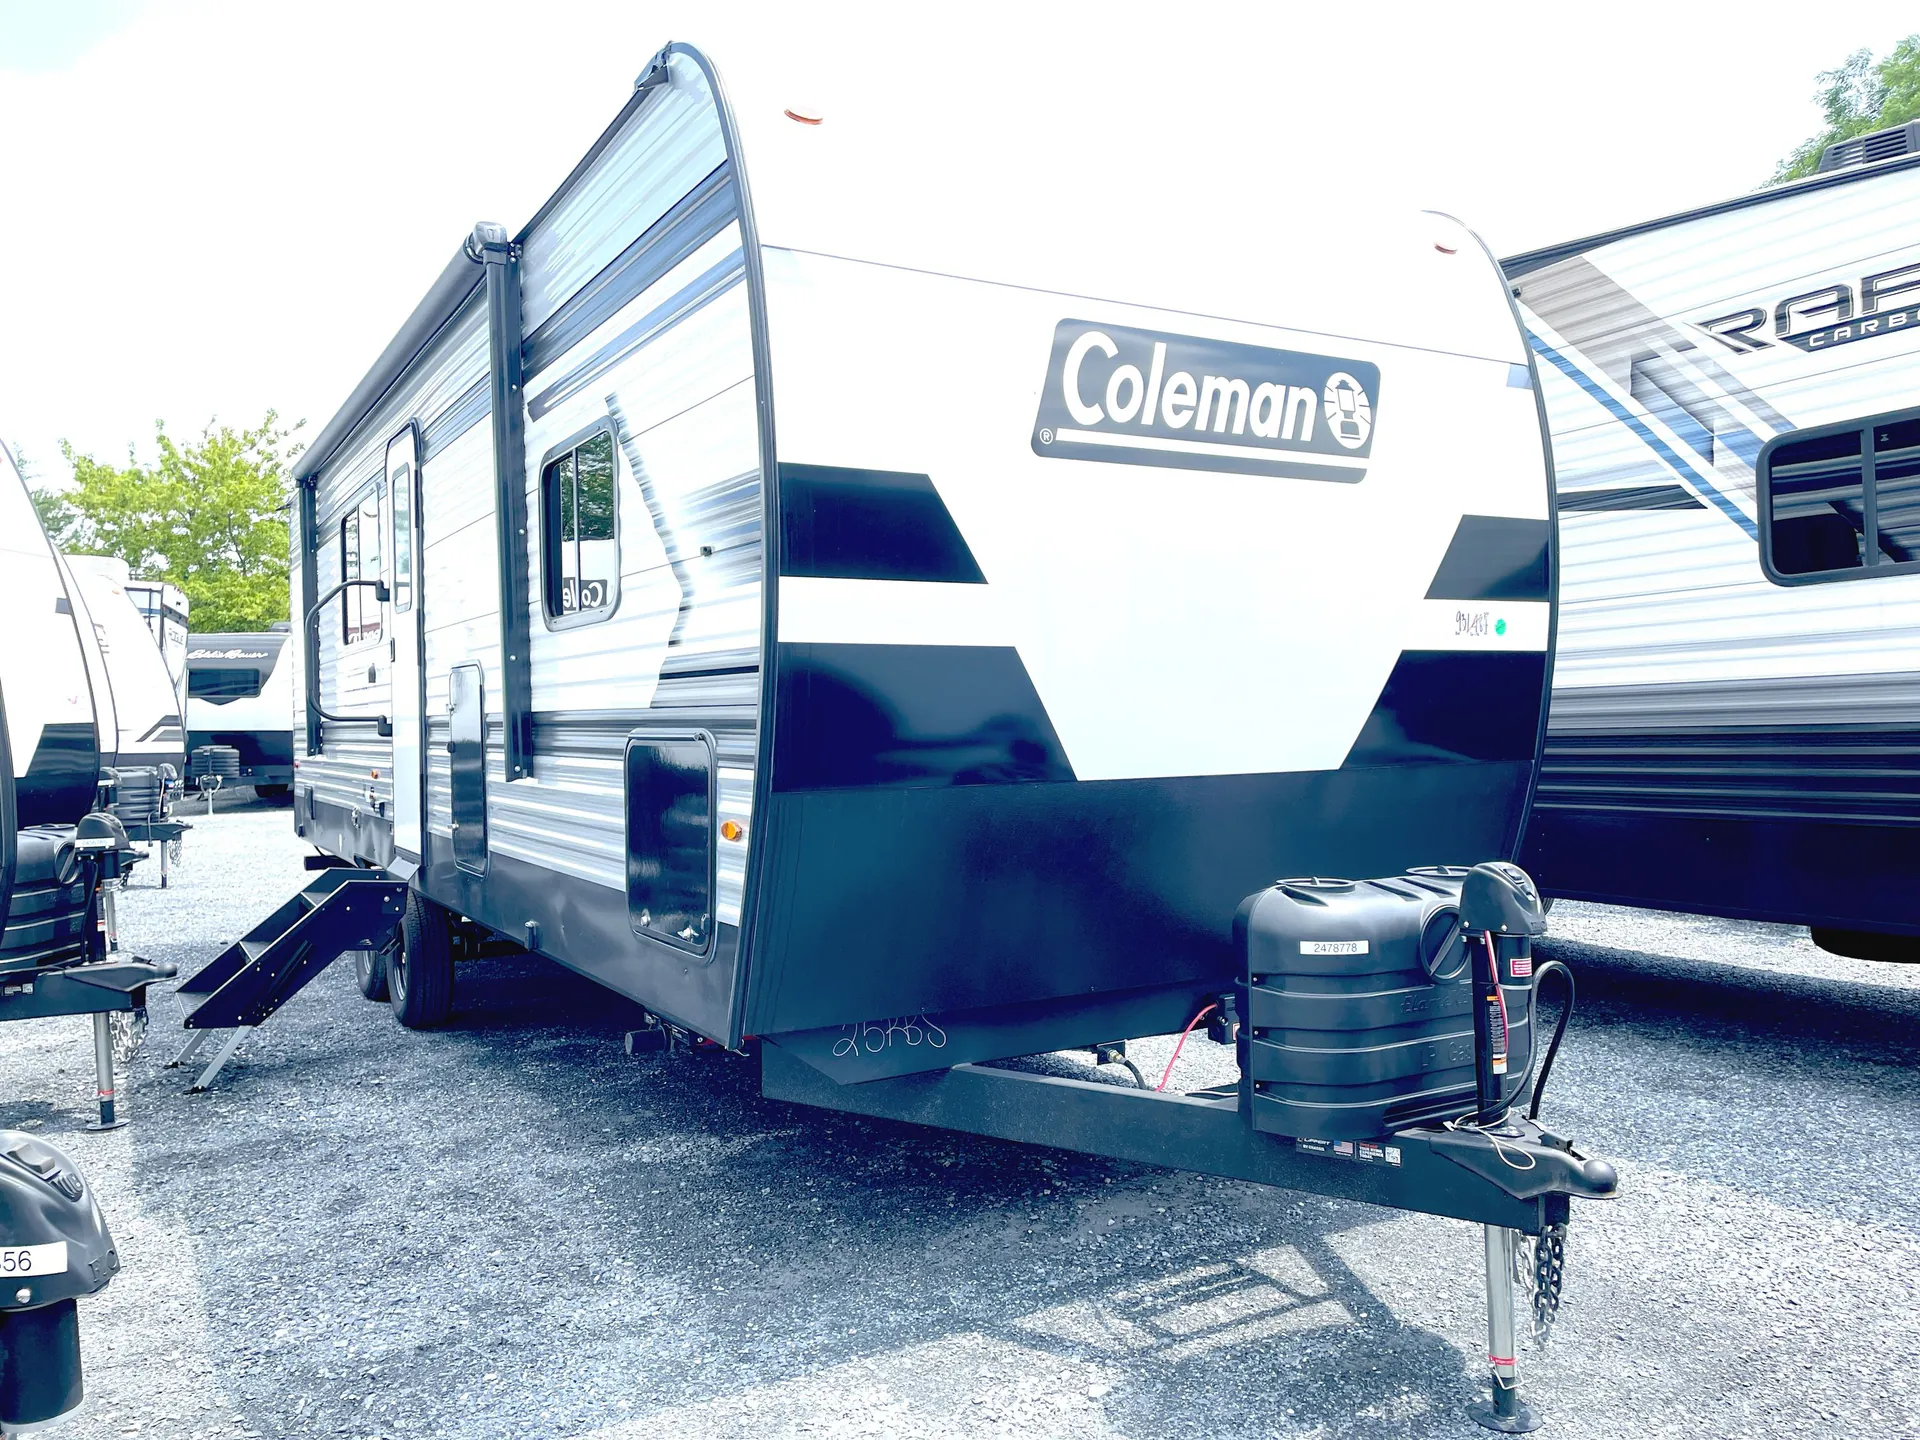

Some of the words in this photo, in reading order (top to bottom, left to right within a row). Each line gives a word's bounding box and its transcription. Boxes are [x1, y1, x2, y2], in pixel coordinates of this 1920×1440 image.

[1808, 308, 1920, 346] CARB
[1063, 330, 1318, 442] Coleman
[1314, 942, 1358, 953] 2478778
[0, 1250, 32, 1272] 56
